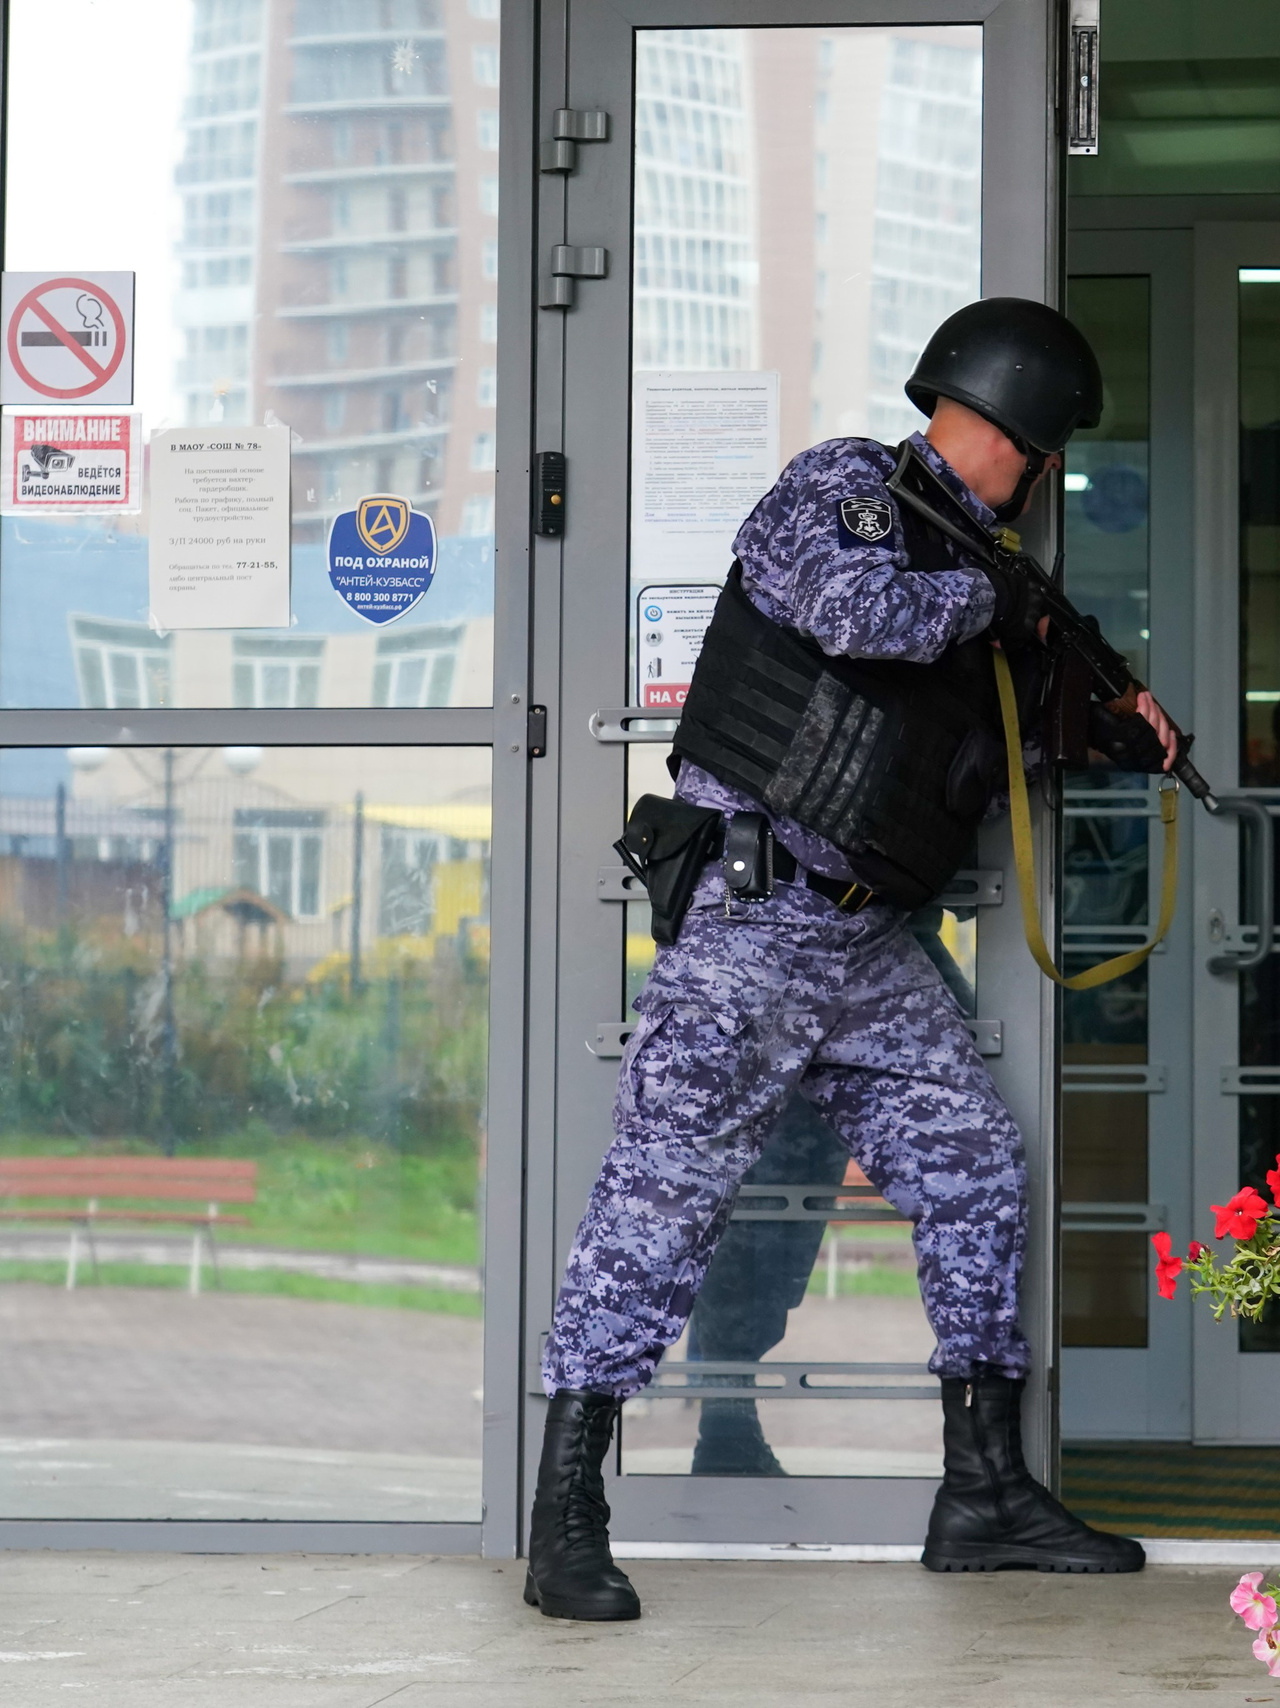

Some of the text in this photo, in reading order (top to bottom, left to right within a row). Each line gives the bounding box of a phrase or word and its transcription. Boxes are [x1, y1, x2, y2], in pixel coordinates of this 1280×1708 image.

[24, 419, 121, 442] ВНИМАНИЕ
[78, 466, 121, 480] ВЕДЁТСЯ
[22, 485, 120, 497] ВИДЕОНАБЛЮДЕНИЕ
[188, 536, 214, 545] 24000
[236, 560, 278, 569] 77-21-55,
[335, 555, 429, 570] ПОД ОХРАНОЙ
[346, 592, 413, 602] 8 800 300 8771
[650, 690, 688, 703] НА С
